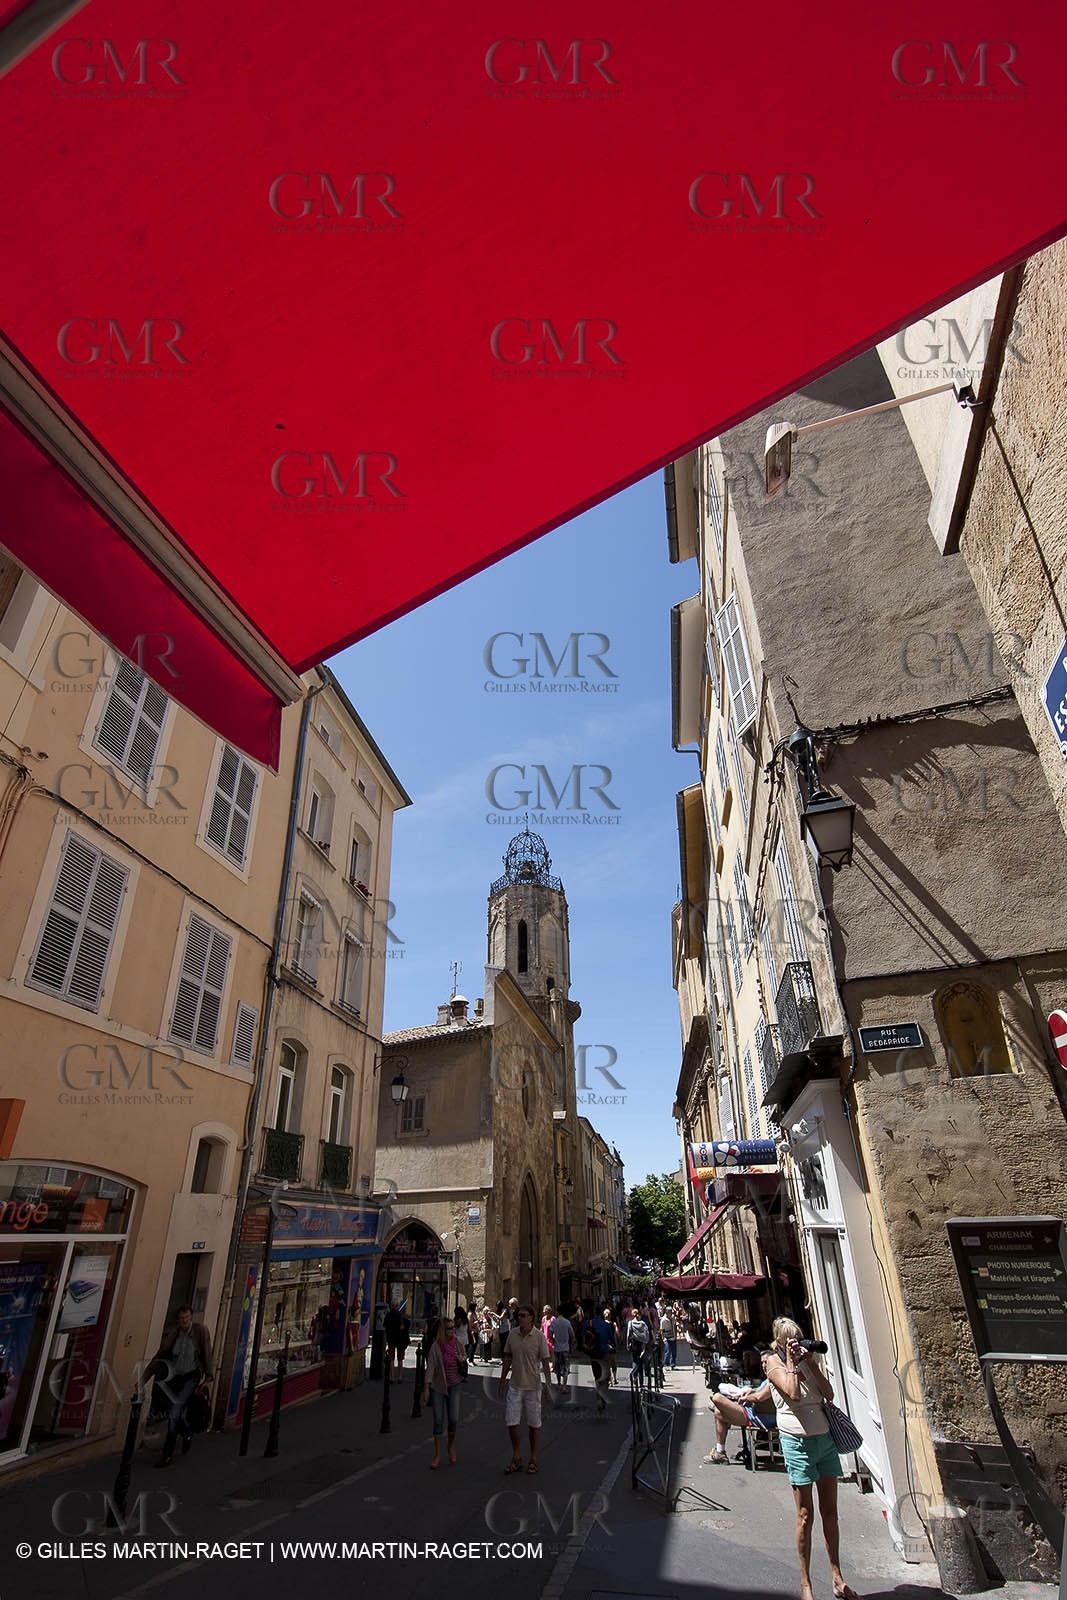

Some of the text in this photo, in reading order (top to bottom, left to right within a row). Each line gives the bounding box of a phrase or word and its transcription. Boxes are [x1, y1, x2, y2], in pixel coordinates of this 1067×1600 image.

[868, 1036, 910, 1048] BEDARRIDE
[986, 1230, 1034, 1239] ARMENAK
[1030, 1275, 1056, 1284] tirages
[991, 1307, 1012, 1315] Tirages
